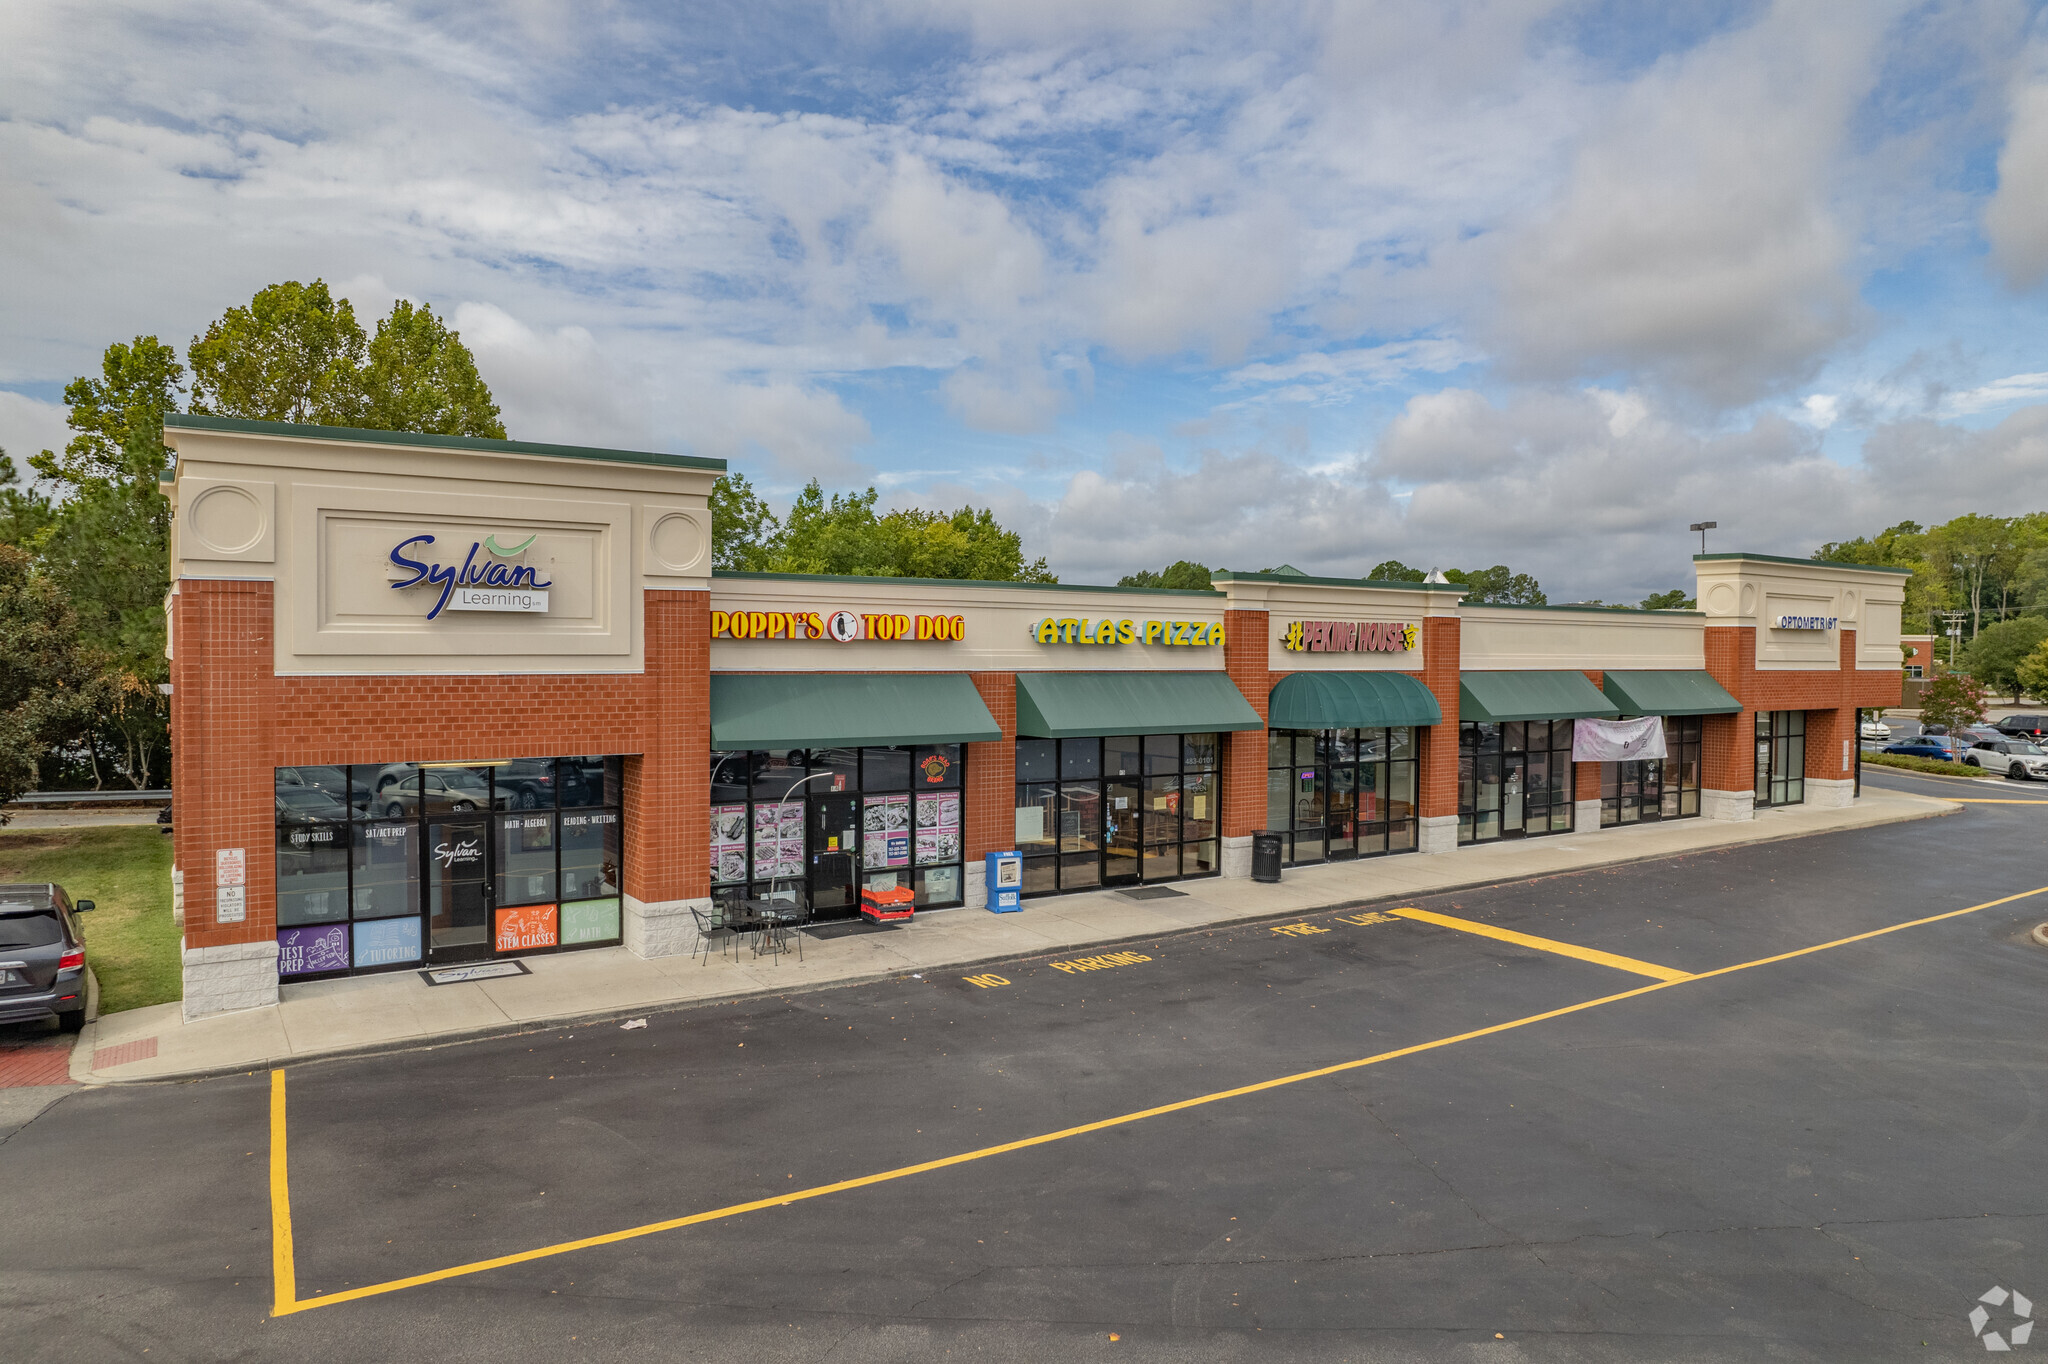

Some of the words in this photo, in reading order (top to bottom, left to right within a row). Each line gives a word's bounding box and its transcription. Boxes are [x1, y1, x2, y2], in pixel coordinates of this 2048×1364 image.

[389, 534, 552, 620] Sylvan
[463, 591, 532, 609] Learning
[711, 610, 824, 640] POPPY'S
[861, 613, 911, 640] TOP
[915, 614, 965, 641] DOG
[1781, 615, 1838, 630] OPTOMETRIST
[1035, 617, 1136, 645] ATLAS
[1142, 620, 1226, 646] PIZZA
[1302, 621, 1356, 652] PEKING
[1357, 622, 1404, 652] HOUSE
[1403, 623, 1420, 651] 京
[504, 821, 520, 829] MATH
[524, 818, 547, 828] ALGEBRA
[563, 816, 587, 826] READING
[591, 814, 617, 824] WRITING
[290, 833, 311, 844] STUDY
[311, 831, 334, 842] SKILLS
[365, 828, 390, 839] SAT/ACT
[391, 827, 407, 837] PREP
[434, 842, 483, 868] Sylvan
[226, 890, 236, 898] NO
[579, 926, 600, 940] MATH
[1269, 922, 1332, 938] FIRE
[1334, 911, 1402, 926] LANE
[497, 935, 519, 950] STEM
[521, 931, 555, 947] CLASSES
[280, 945, 304, 960] TEST
[370, 945, 417, 962] TUTORING
[280, 959, 304, 973] PREP
[962, 973, 1011, 989] NO
[1048, 951, 1153, 974] PARKING
